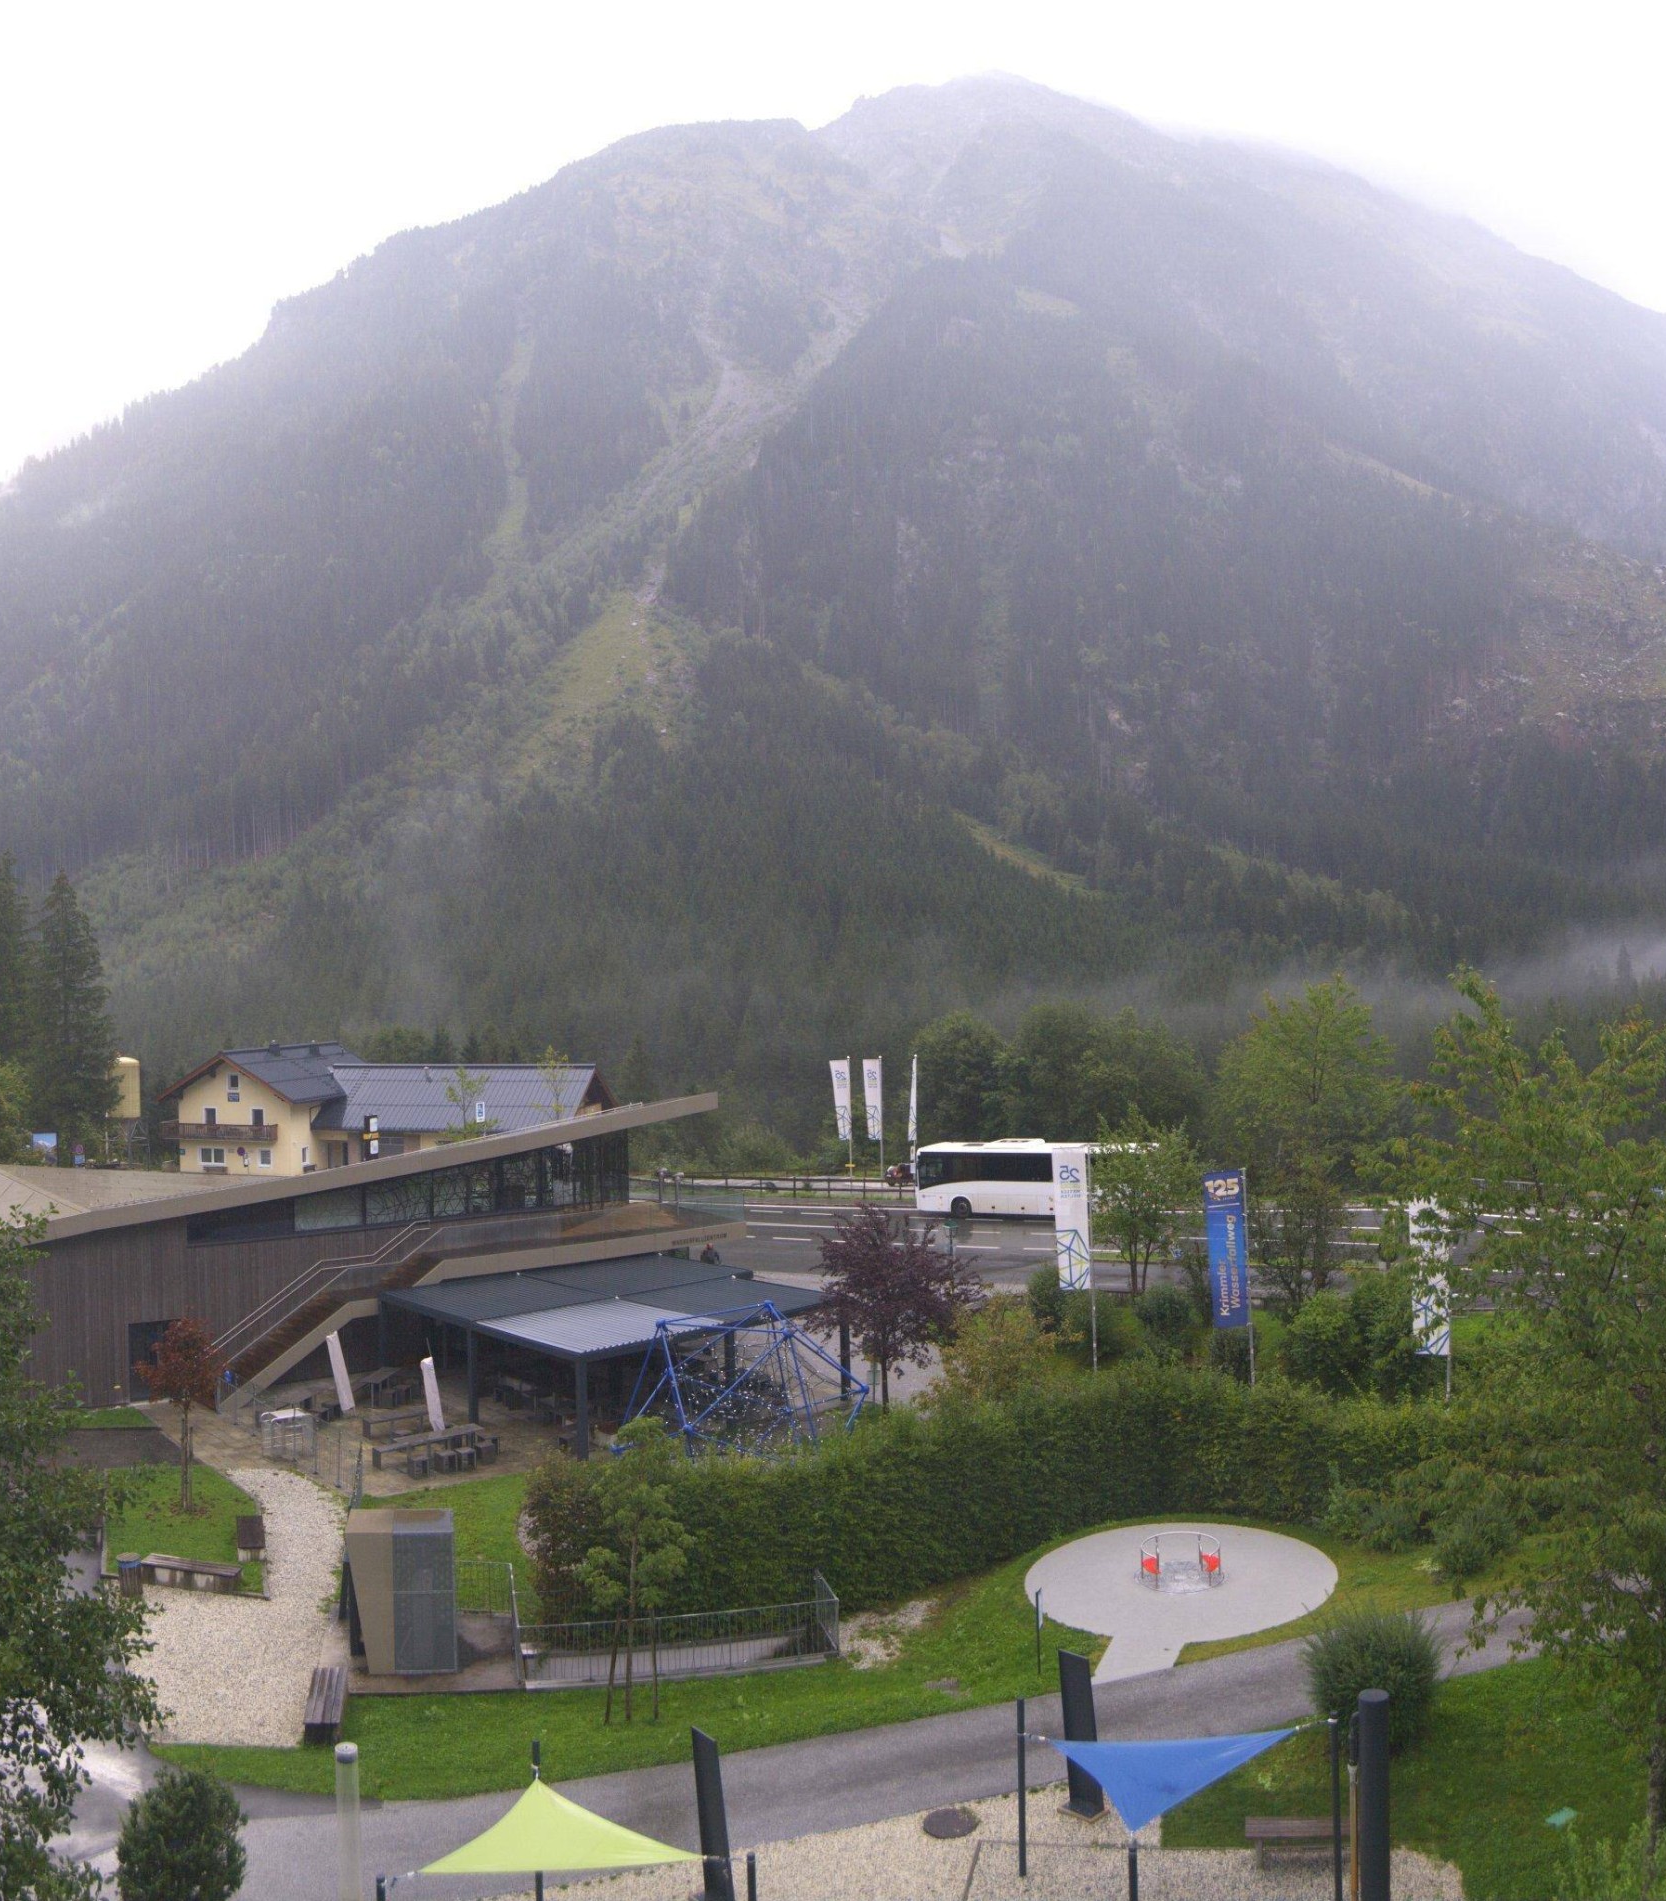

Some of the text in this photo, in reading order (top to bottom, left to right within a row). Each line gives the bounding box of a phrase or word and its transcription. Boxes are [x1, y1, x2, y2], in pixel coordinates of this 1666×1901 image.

[1204, 1178, 1240, 1197] 125
[1217, 1260, 1231, 1317] Krimmler
[1226, 1215, 1242, 1309] Wasserfallweg
